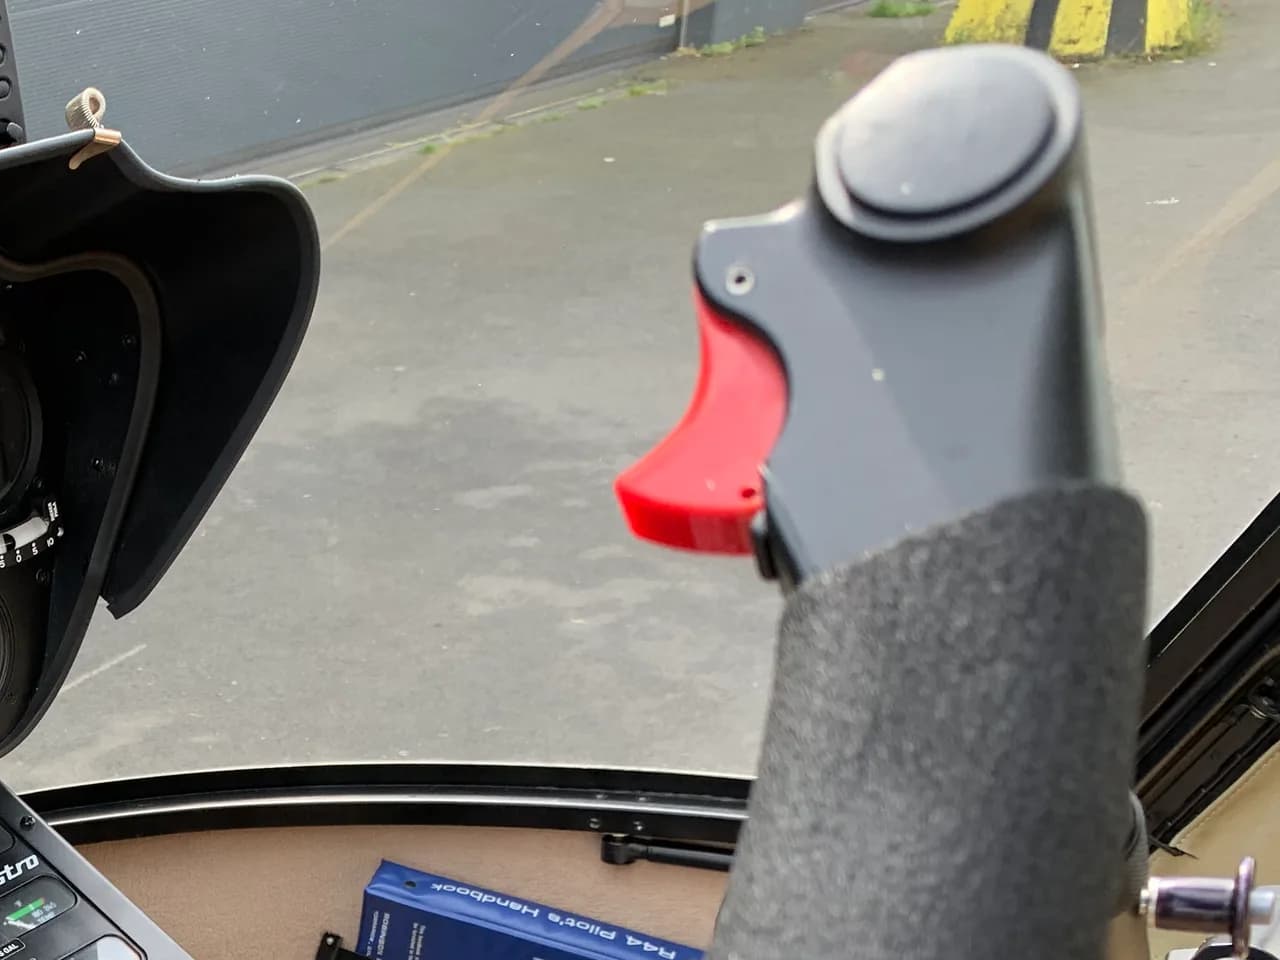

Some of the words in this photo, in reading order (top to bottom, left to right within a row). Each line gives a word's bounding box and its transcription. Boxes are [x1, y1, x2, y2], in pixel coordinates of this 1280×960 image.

[431, 883, 539, 918] Handbook
[548, 912, 617, 941] Pilot's
[3, 943, 19, 955] GAL
[625, 933, 677, 960] R44
